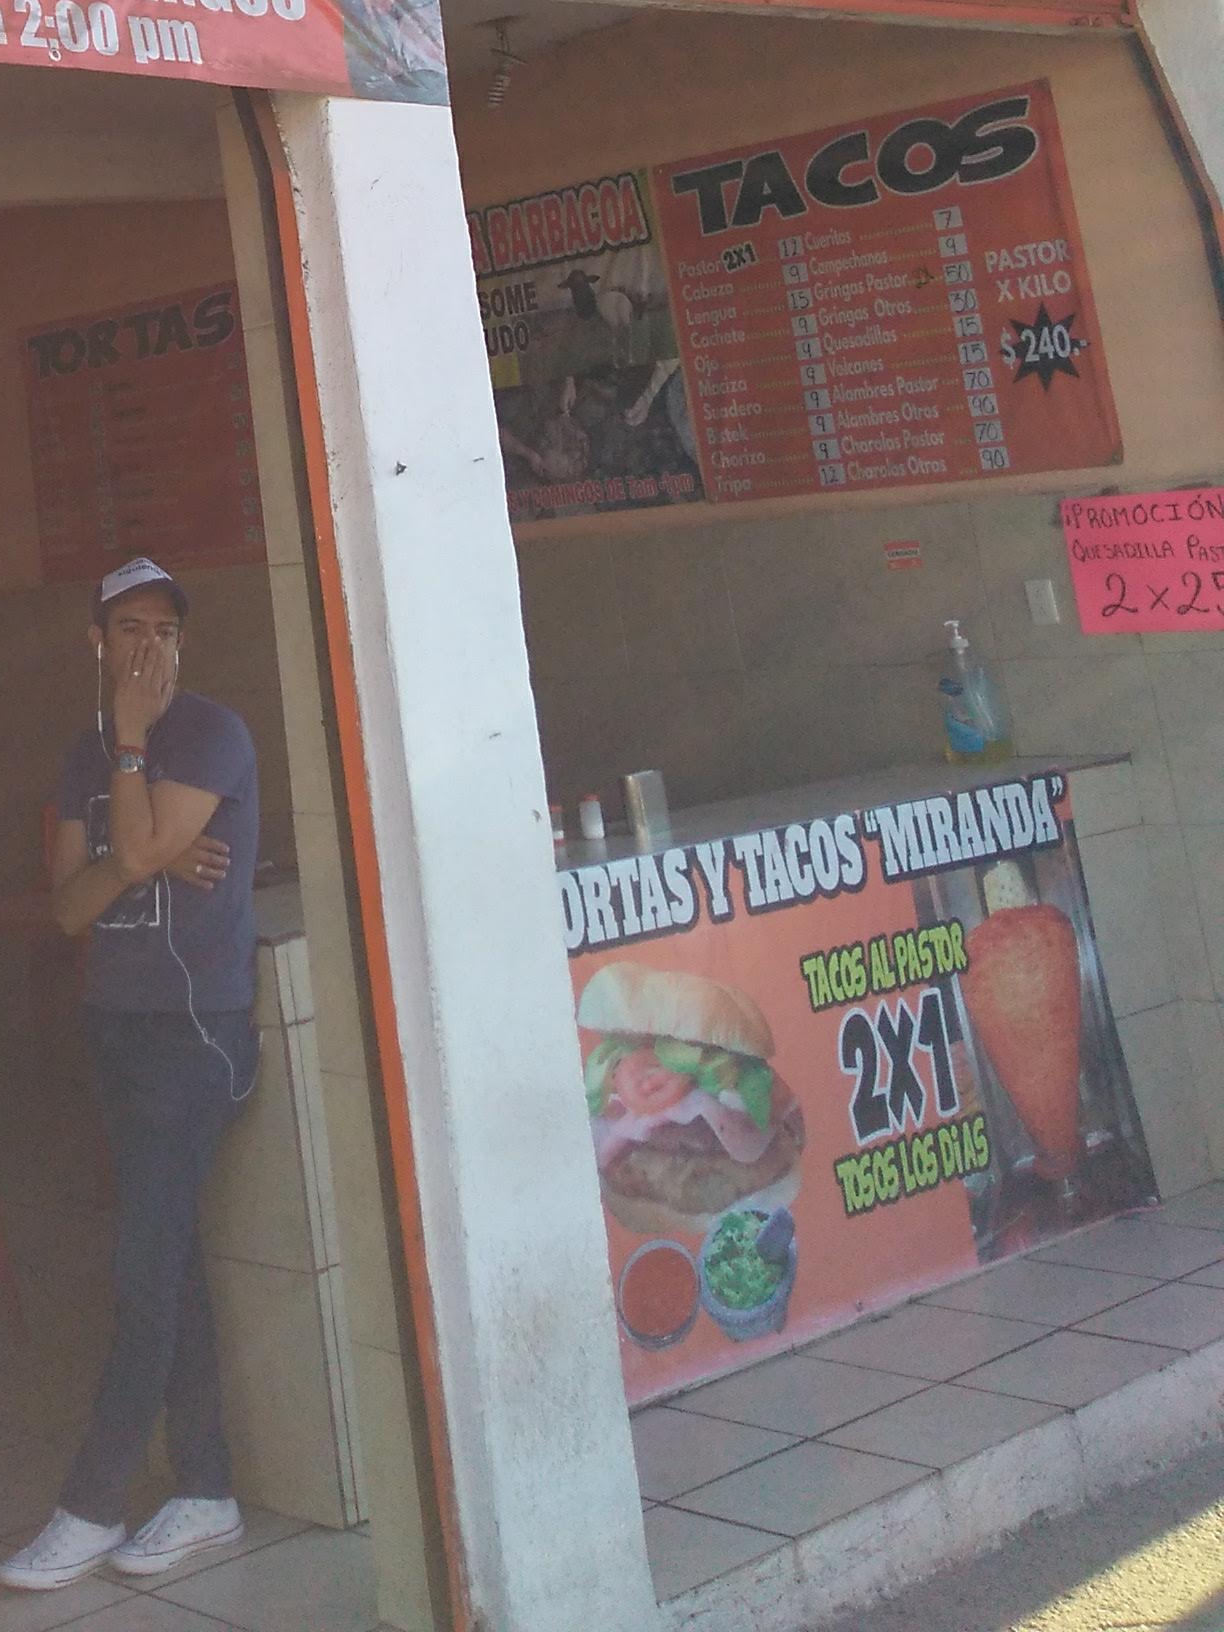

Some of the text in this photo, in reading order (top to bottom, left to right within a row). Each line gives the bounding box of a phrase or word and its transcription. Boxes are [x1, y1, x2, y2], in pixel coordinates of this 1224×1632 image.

[127, 13, 203, 66] pm
[671, 95, 1038, 236] TACOS
[487, 174, 648, 272] BARBACOA
[938, 209, 952, 228] 7
[678, 259, 721, 279] Pastor
[809, 250, 889, 276] Campechanos
[985, 239, 1071, 274] PASTOR
[682, 281, 735, 302] Cabeza
[814, 280, 865, 303] Gringas
[865, 272, 909, 294] Pastor
[996, 270, 1072, 304] X KILO
[685, 292, 810, 327] Lengua 15
[818, 305, 869, 328] Gringas
[873, 297, 913, 318] Otros
[28, 290, 236, 378] TORTAS
[690, 329, 746, 349] Cachete
[823, 324, 897, 355] Quesadillas
[961, 344, 985, 364] 15
[832, 369, 990, 404] Alambres Pastor 70
[838, 405, 900, 429] Alambres
[901, 401, 940, 420] Otros
[707, 423, 749, 445] Bstek
[902, 428, 945, 449] Pastor
[976, 422, 999, 442] 70
[906, 455, 947, 475] Otros
[982, 448, 1006, 469] 90
[1072, 539, 1176, 563] QUESADILLA
[1101, 572, 1139, 617] 2
[695, 839, 731, 916] Y
[733, 814, 864, 908] TACOS
[802, 921, 968, 1008] TACOS AL PASTOR
[838, 987, 960, 1146] 2X1
[899, 1132, 939, 1193] LOS
